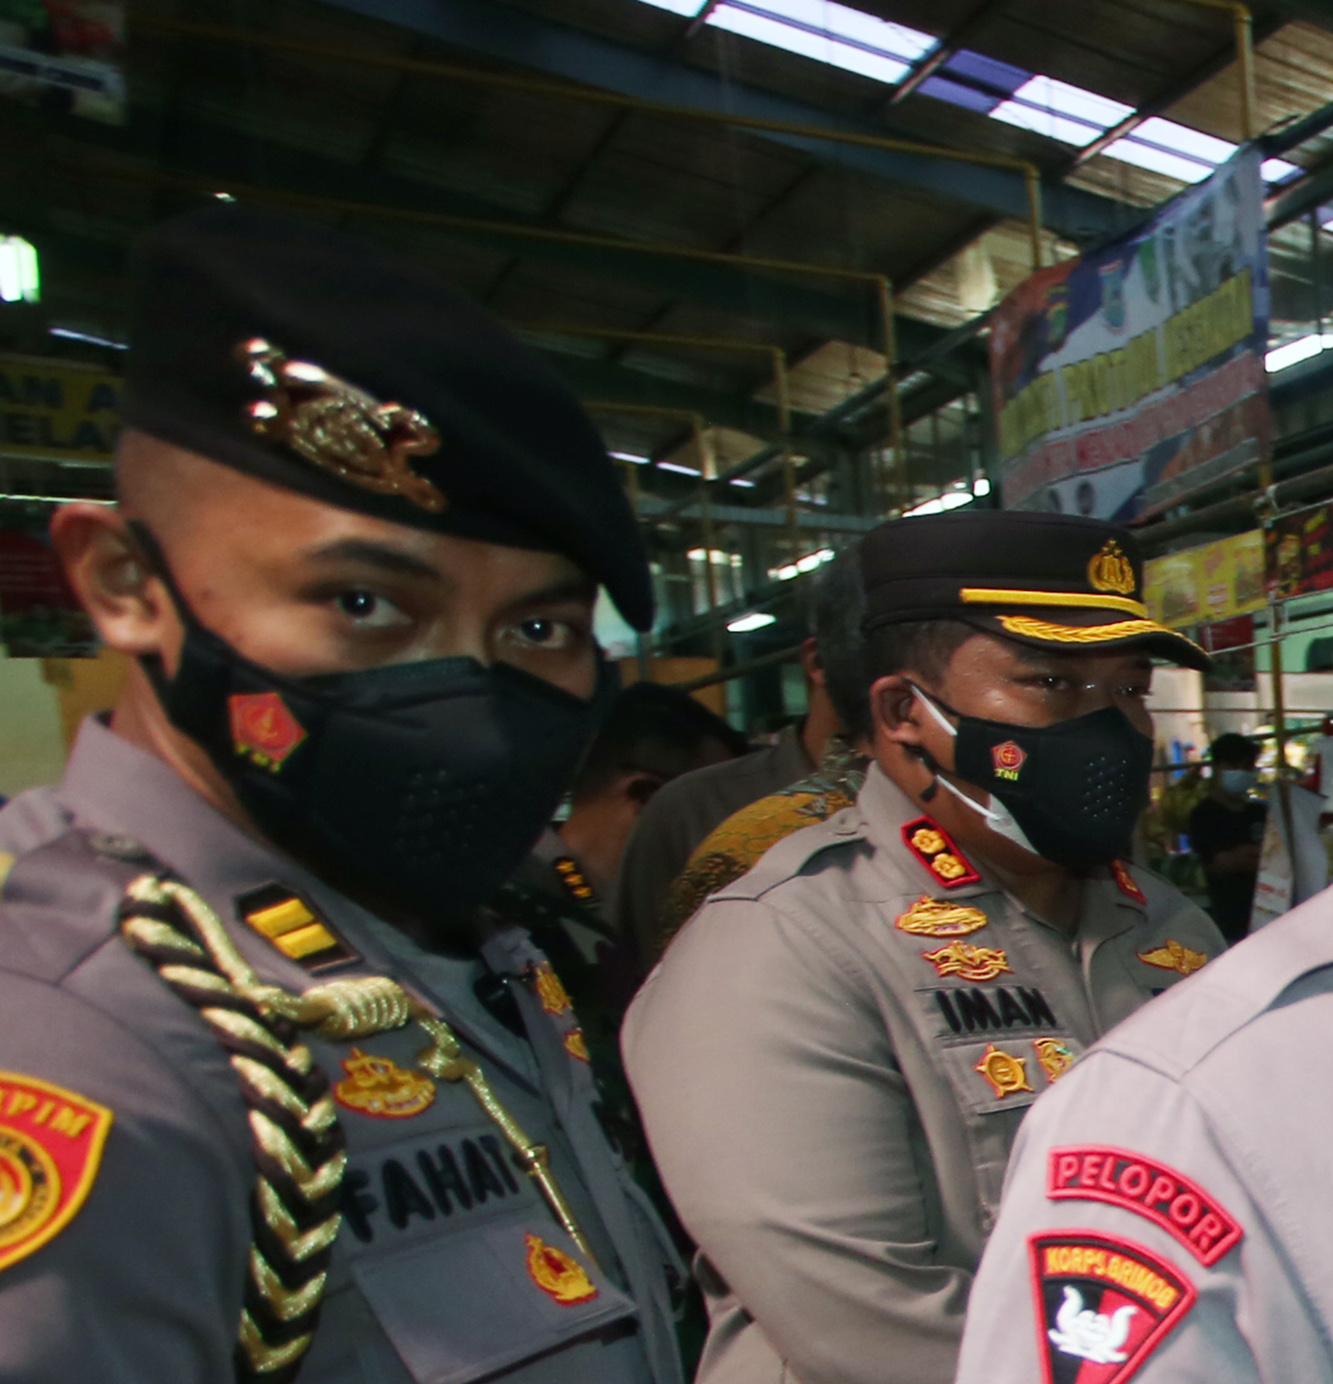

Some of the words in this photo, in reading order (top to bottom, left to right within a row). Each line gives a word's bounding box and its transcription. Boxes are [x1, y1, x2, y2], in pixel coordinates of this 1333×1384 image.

[935, 986, 1057, 1033] IMAN
[0, 1089, 92, 1138] PIM
[1057, 1155, 1223, 1251] PELOPOR
[1045, 1247, 1106, 1276] KORPS
[1106, 1255, 1180, 1309] BRIMOB
